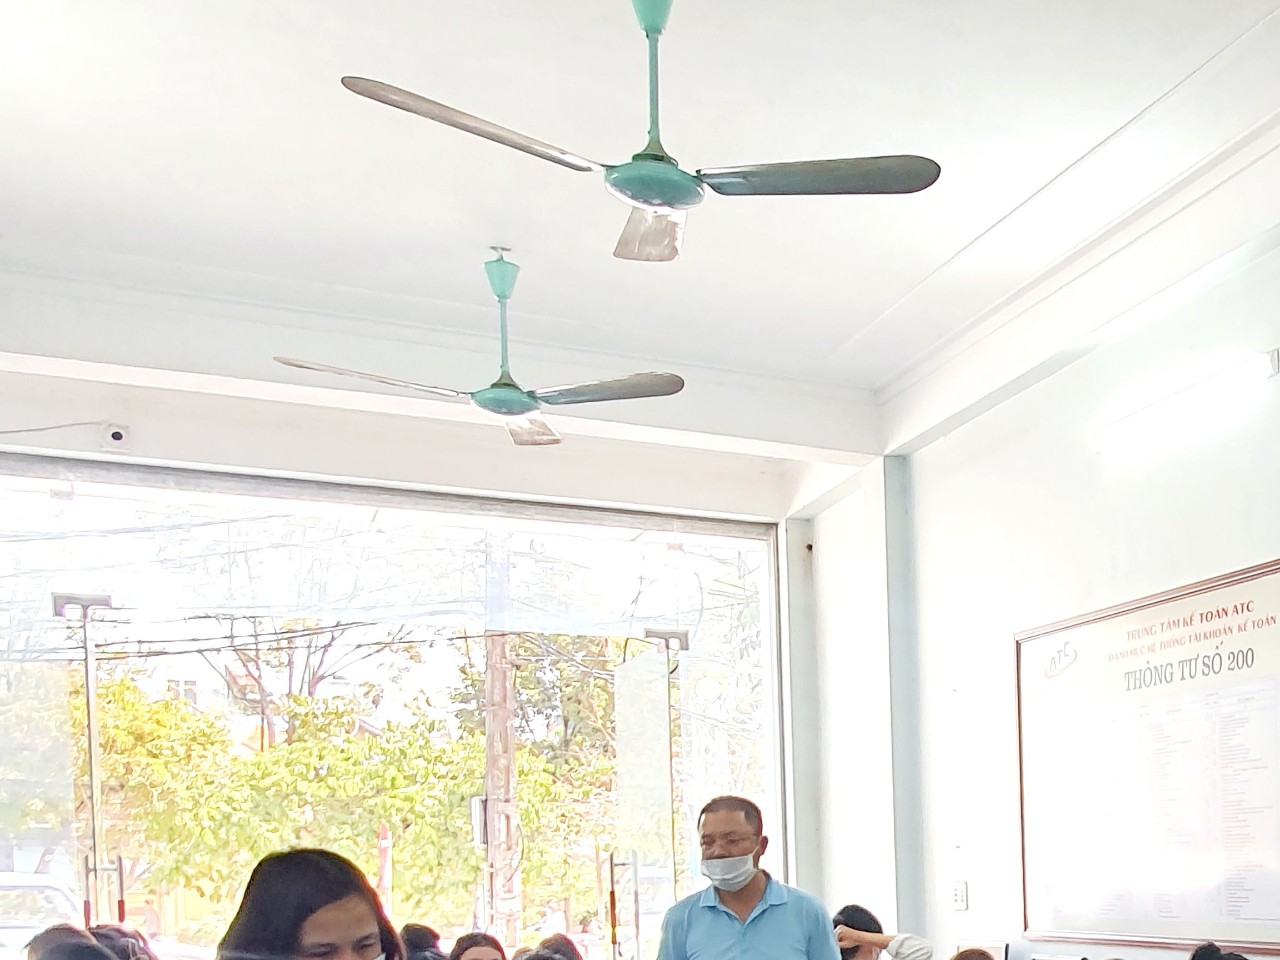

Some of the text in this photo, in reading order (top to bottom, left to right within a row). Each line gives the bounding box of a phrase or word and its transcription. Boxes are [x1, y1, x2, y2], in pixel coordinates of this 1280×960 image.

[1126, 624, 1157, 642] TRUNG
[1199, 605, 1229, 624] TOÁN
[1232, 600, 1255, 615] ATC
[1252, 612, 1277, 630] TOÁN
[1049, 641, 1070, 672] ATC
[1178, 653, 1199, 681] TƯ
[1202, 641, 1224, 677] SỐ
[1227, 647, 1255, 672] 200
